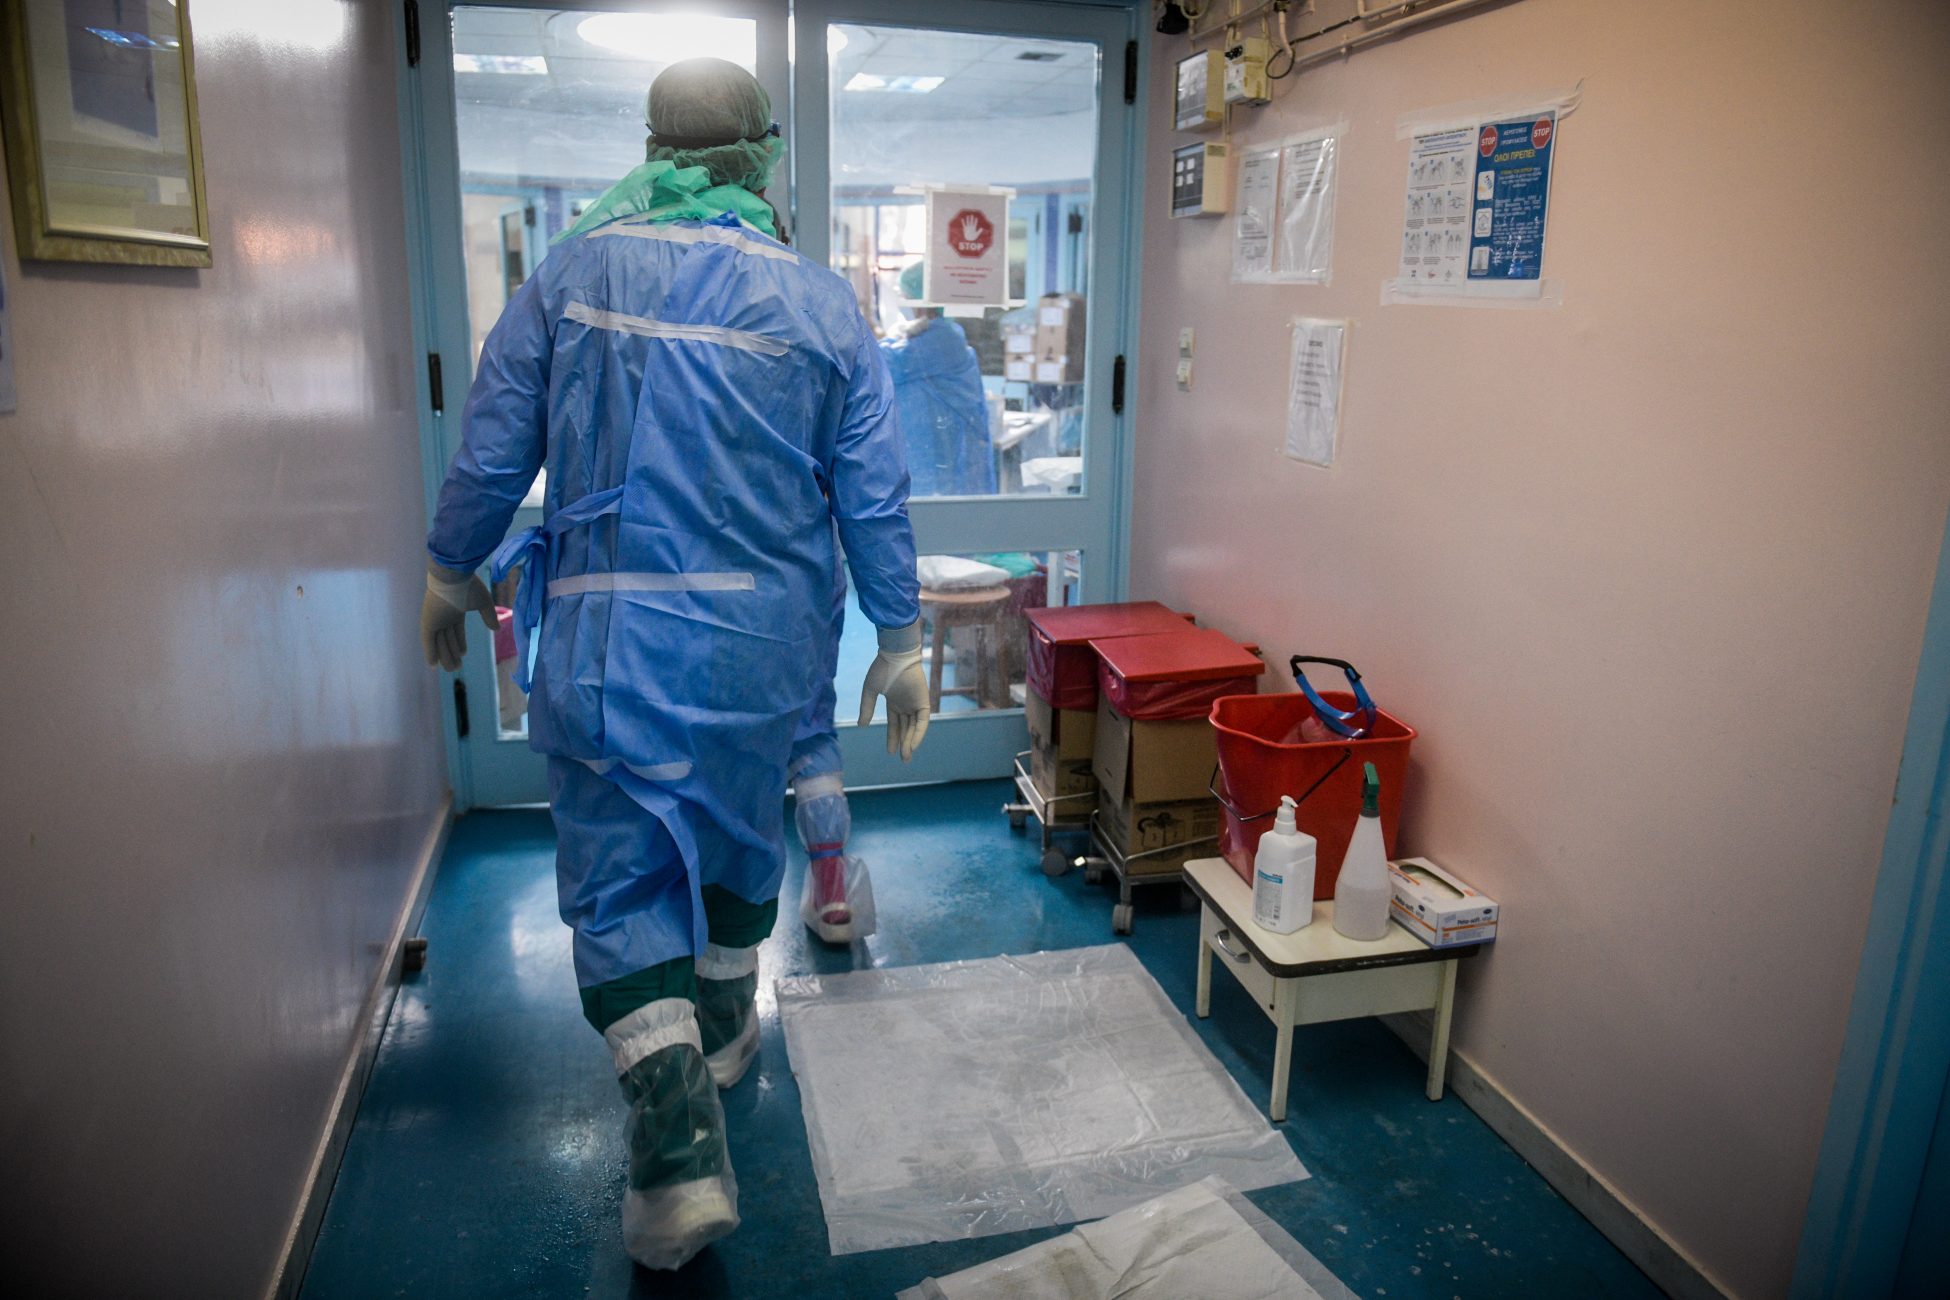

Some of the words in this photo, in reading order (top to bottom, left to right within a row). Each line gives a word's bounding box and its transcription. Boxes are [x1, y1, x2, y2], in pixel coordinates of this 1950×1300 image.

[1533, 127, 1551, 138] STOP
[1481, 136, 1496, 146] STOP
[958, 241, 984, 251] STOP
